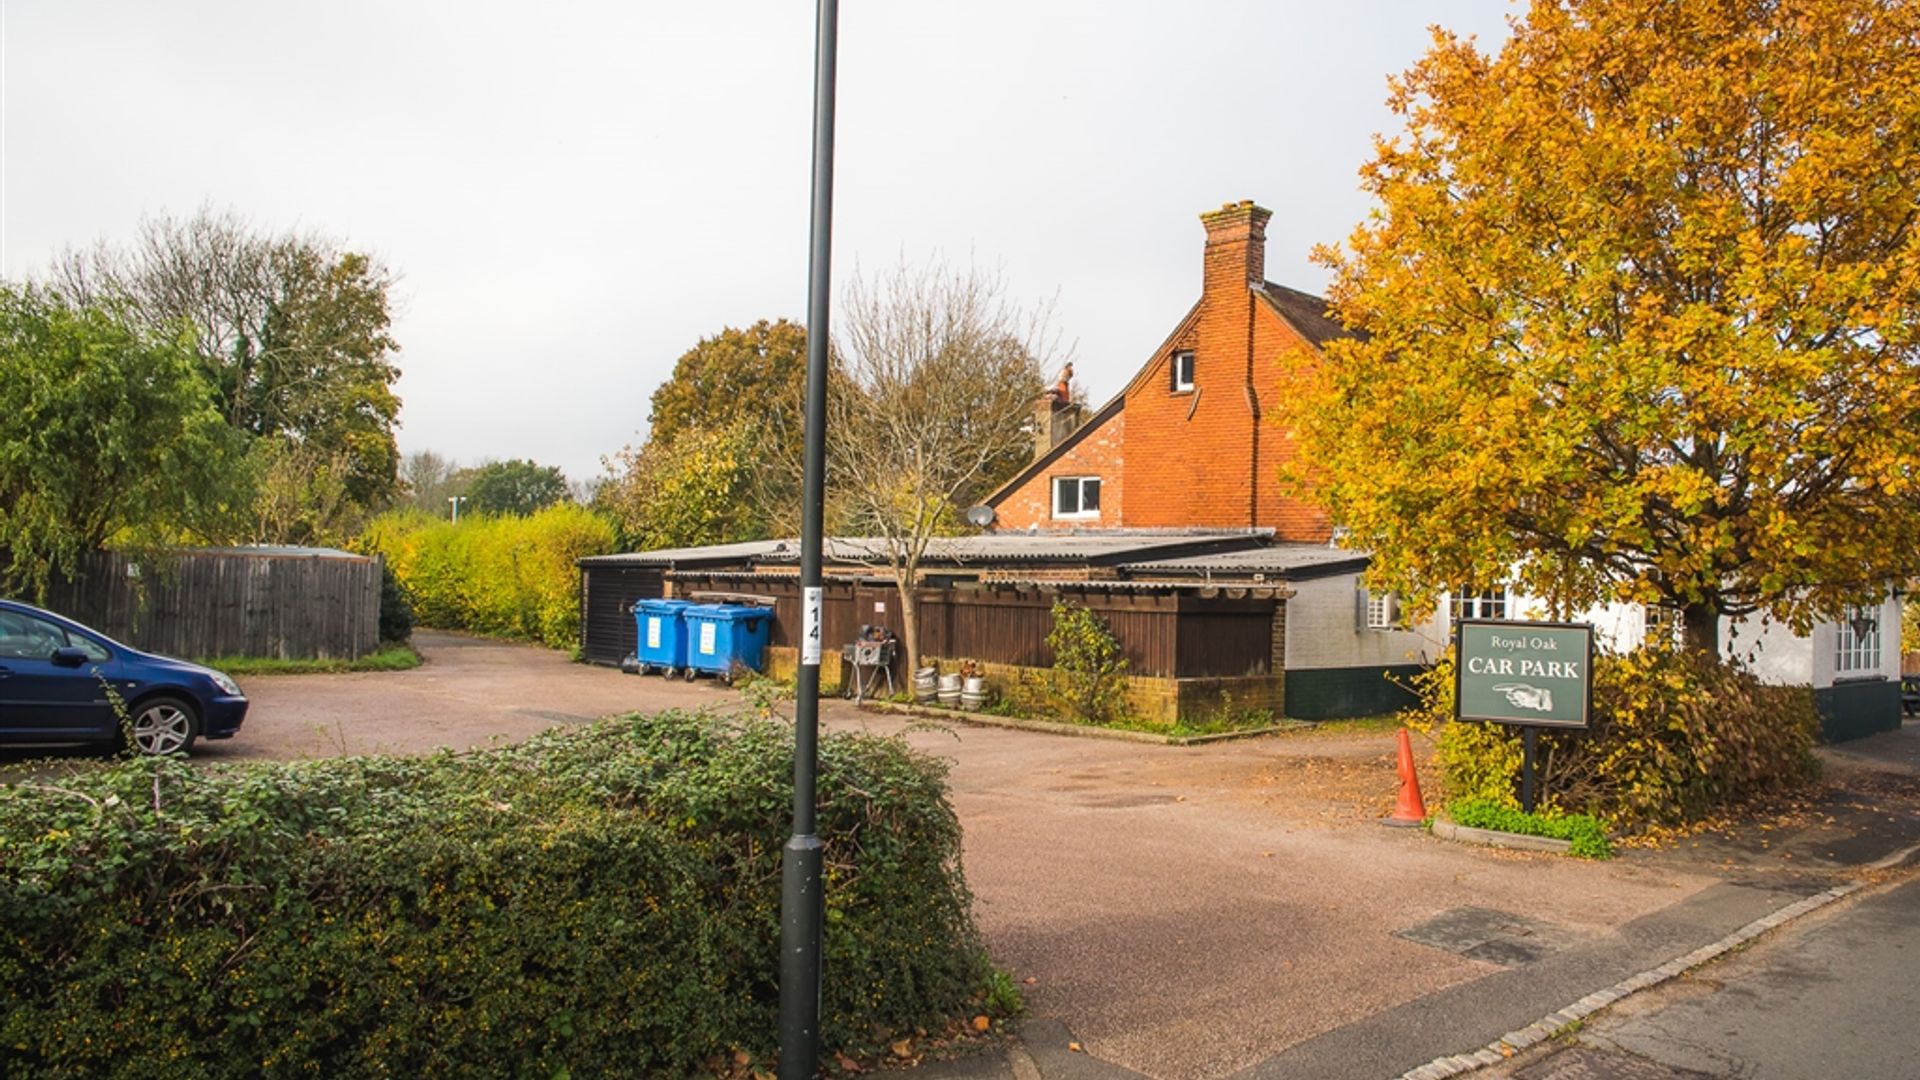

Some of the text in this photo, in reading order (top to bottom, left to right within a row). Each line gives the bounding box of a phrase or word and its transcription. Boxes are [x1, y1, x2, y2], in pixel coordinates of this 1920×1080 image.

[1491, 635, 1558, 651] Royal Oak
[1468, 656, 1579, 679] CAR PARK
